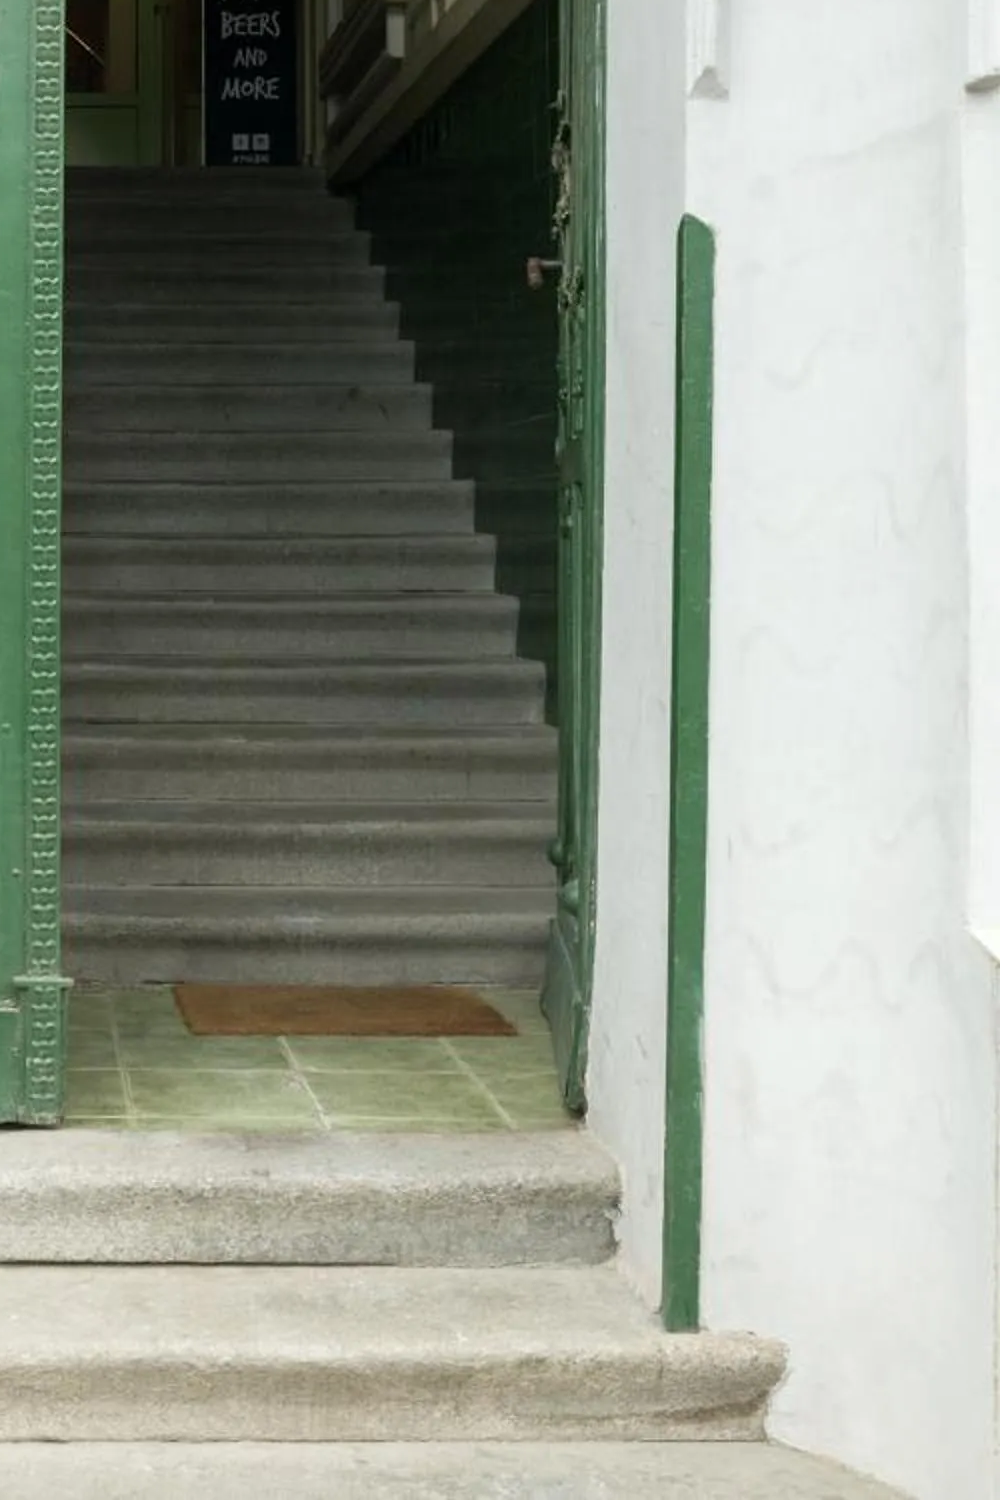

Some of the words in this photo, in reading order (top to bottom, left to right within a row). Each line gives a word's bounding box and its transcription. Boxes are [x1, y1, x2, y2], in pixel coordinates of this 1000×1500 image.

[220, 10, 281, 39] BEERS
[233, 47, 268, 69] AND
[221, 75, 281, 101] MORE
